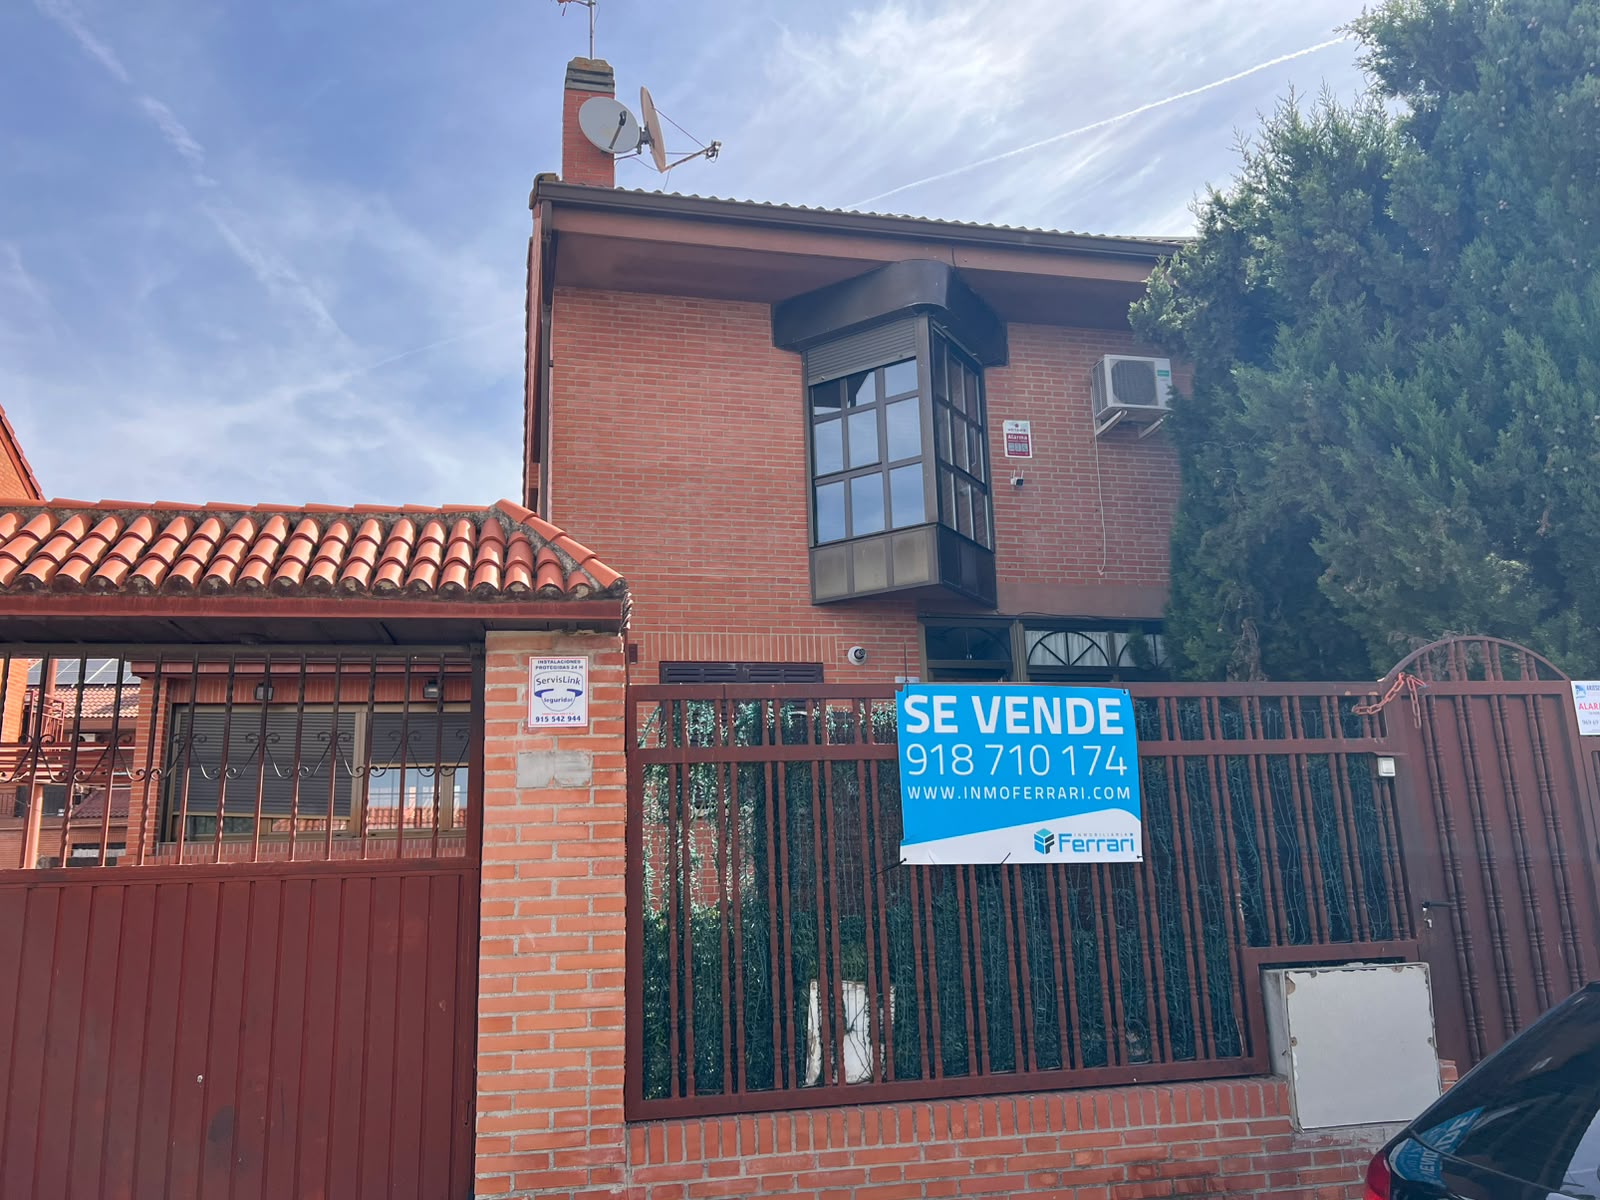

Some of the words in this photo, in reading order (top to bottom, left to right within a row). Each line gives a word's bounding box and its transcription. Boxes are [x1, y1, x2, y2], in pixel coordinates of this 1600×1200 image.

[535, 675, 581, 686] ServisLink
[904, 695, 958, 734] SE
[971, 695, 1124, 735] VENDE
[906, 743, 974, 776] 918
[985, 744, 1050, 776] 710
[1062, 745, 1128, 776] 174
[907, 786, 1131, 800] WWW.INMOFERRARI.COM
[1058, 832, 1135, 853] Ferrari
